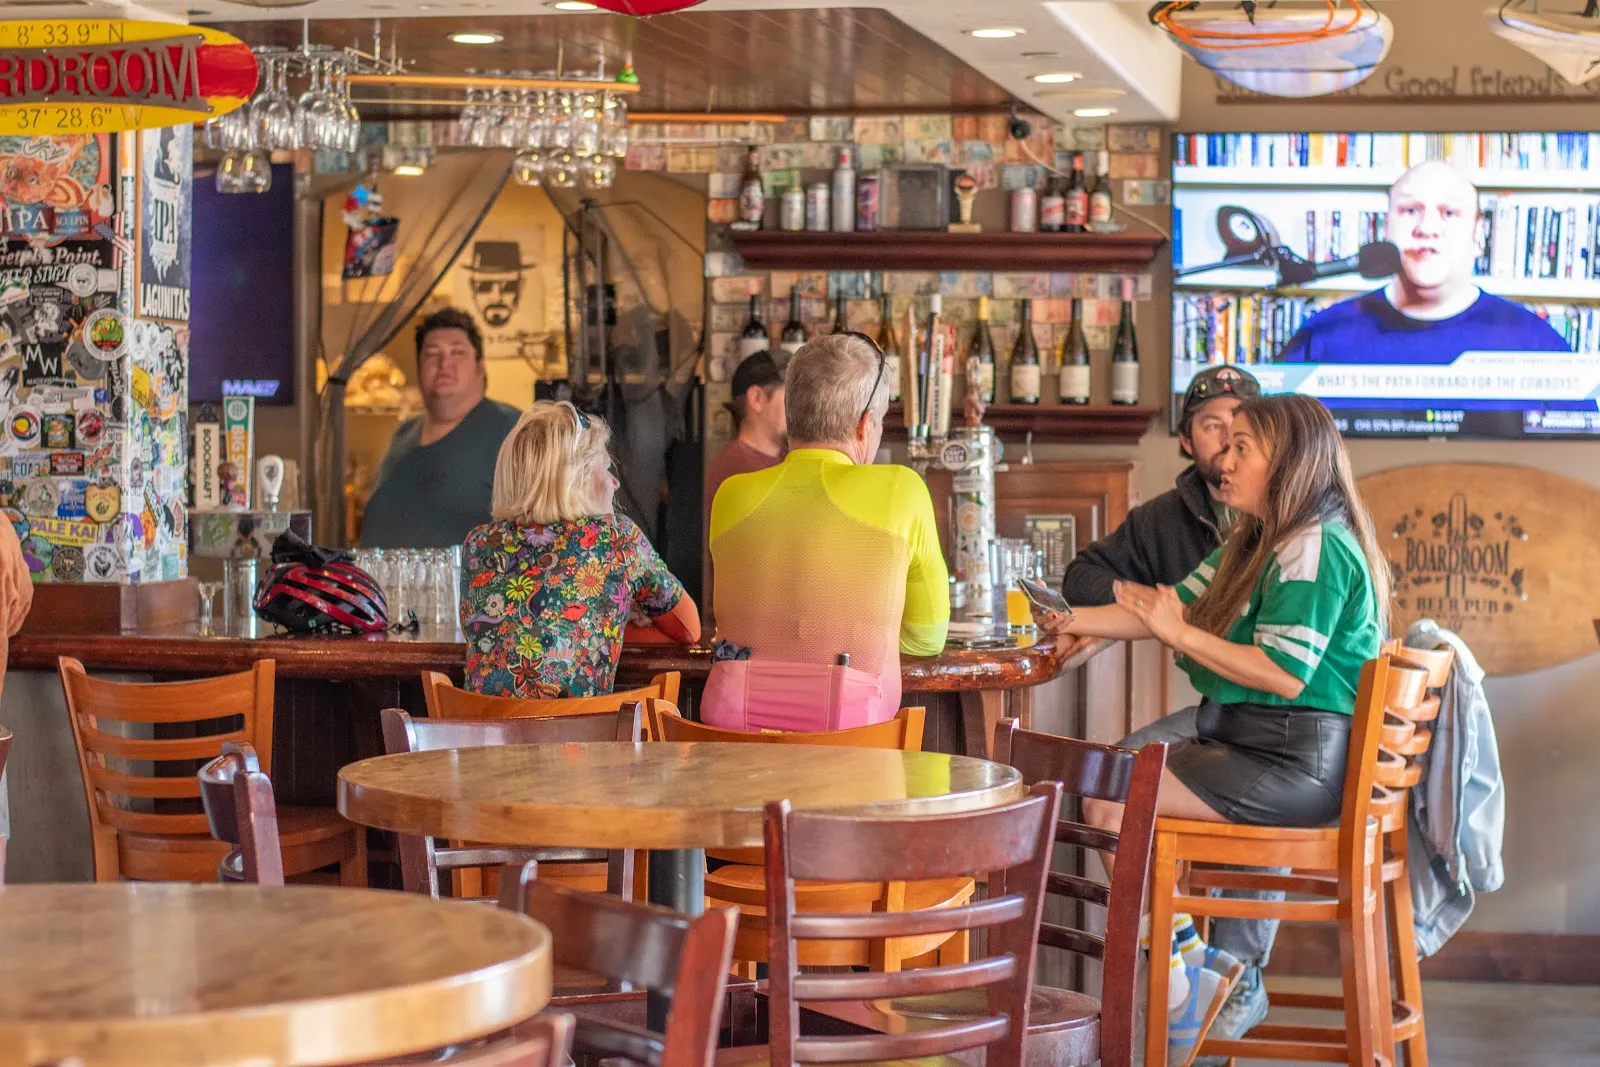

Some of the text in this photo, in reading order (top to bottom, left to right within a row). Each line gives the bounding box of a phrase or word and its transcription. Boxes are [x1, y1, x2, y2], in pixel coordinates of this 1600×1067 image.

[17, 23, 124, 46] 8' 33.9" N
[1385, 66, 1459, 97] Good
[57, 108, 112, 127] 28.6"
[120, 107, 143, 127] W
[154, 198, 175, 243] IPA
[54, 247, 103, 264] Point.
[140, 283, 190, 320] LAGUNITAS
[1362, 375, 1380, 389] THE
[1385, 375, 1413, 389] PATH
[1417, 375, 1469, 389] FORWARD
[1471, 375, 1493, 389] FOR
[1497, 375, 1516, 390] THE
[70, 523, 97, 539] KAI
[1406, 537, 1510, 576] BOARDROOM
[1465, 599, 1498, 613] PUB
